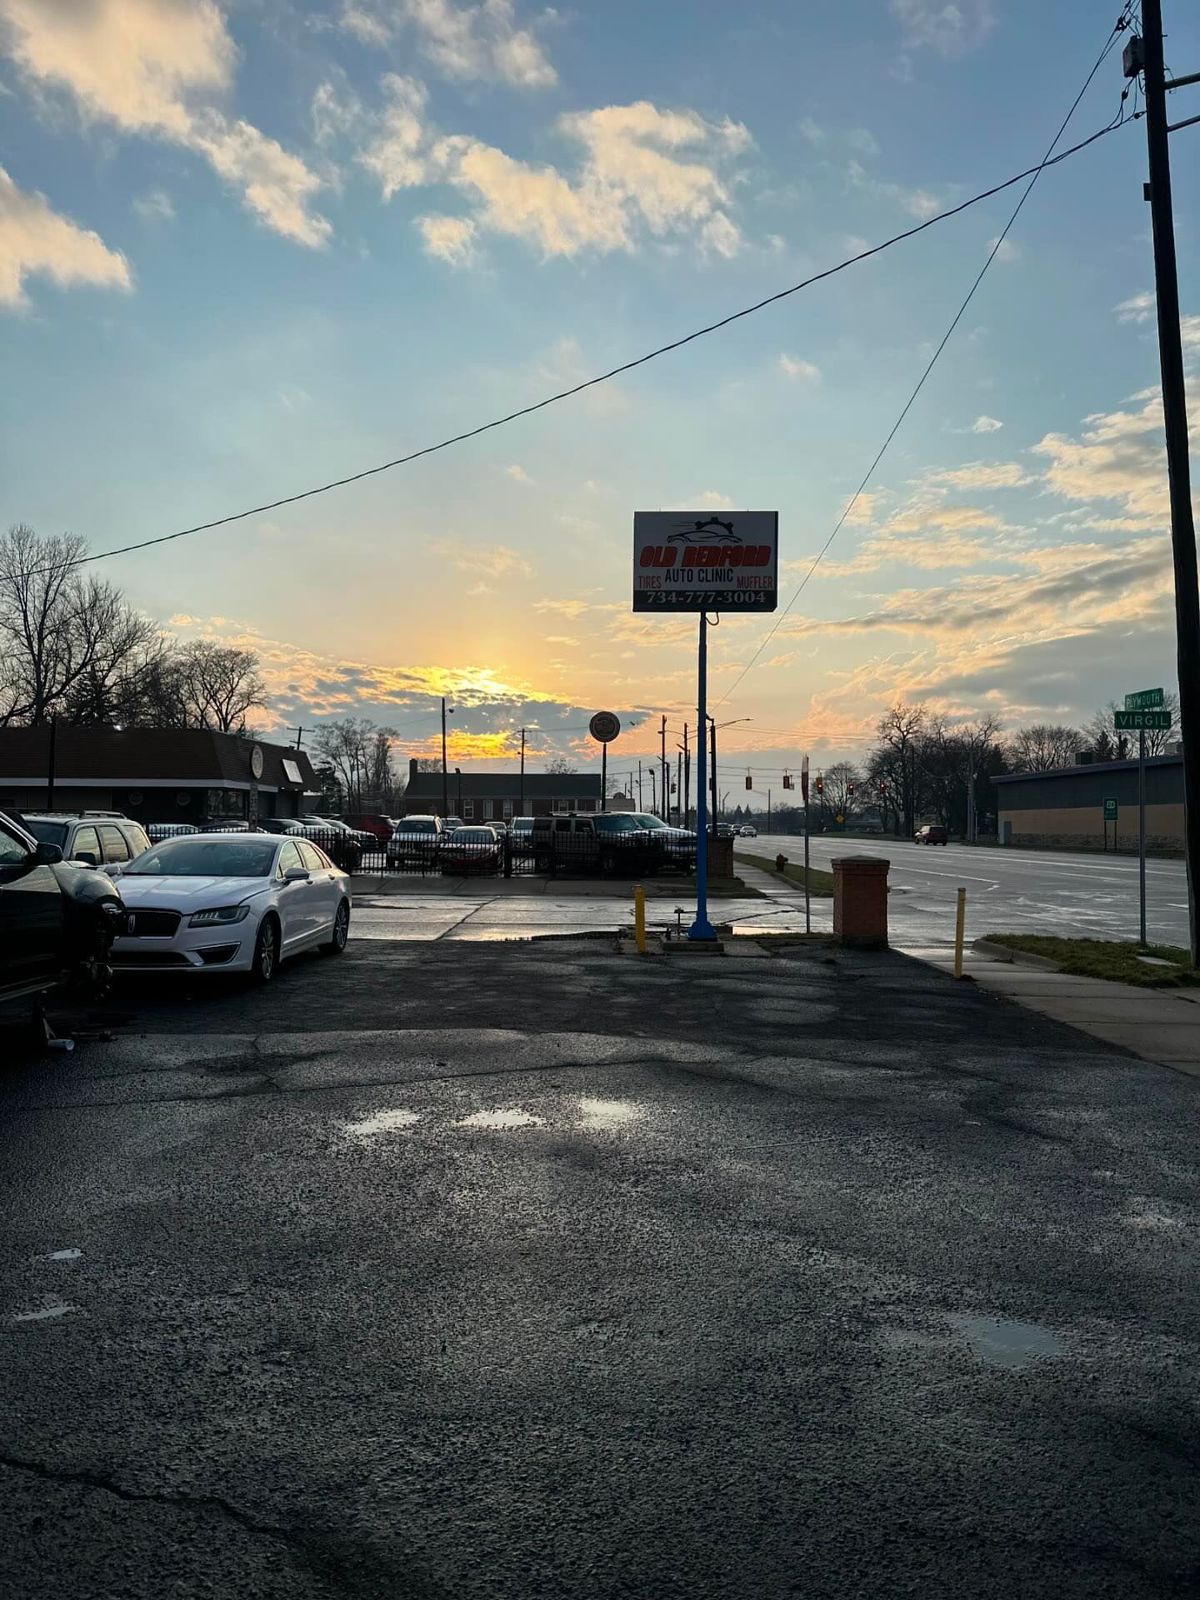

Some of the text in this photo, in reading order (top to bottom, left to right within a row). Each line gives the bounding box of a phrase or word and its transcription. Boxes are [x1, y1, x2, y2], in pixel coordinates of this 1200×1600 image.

[640, 546, 771, 567] OLD REDFORD
[665, 568, 734, 583] AUTO CLINIC
[639, 576, 662, 589] TIRES
[736, 576, 773, 589] MUFFLER
[647, 592, 766, 603] 734-777-3004
[1126, 693, 1160, 708] PLYMOUTH
[1119, 715, 1169, 726] VIRGIL
